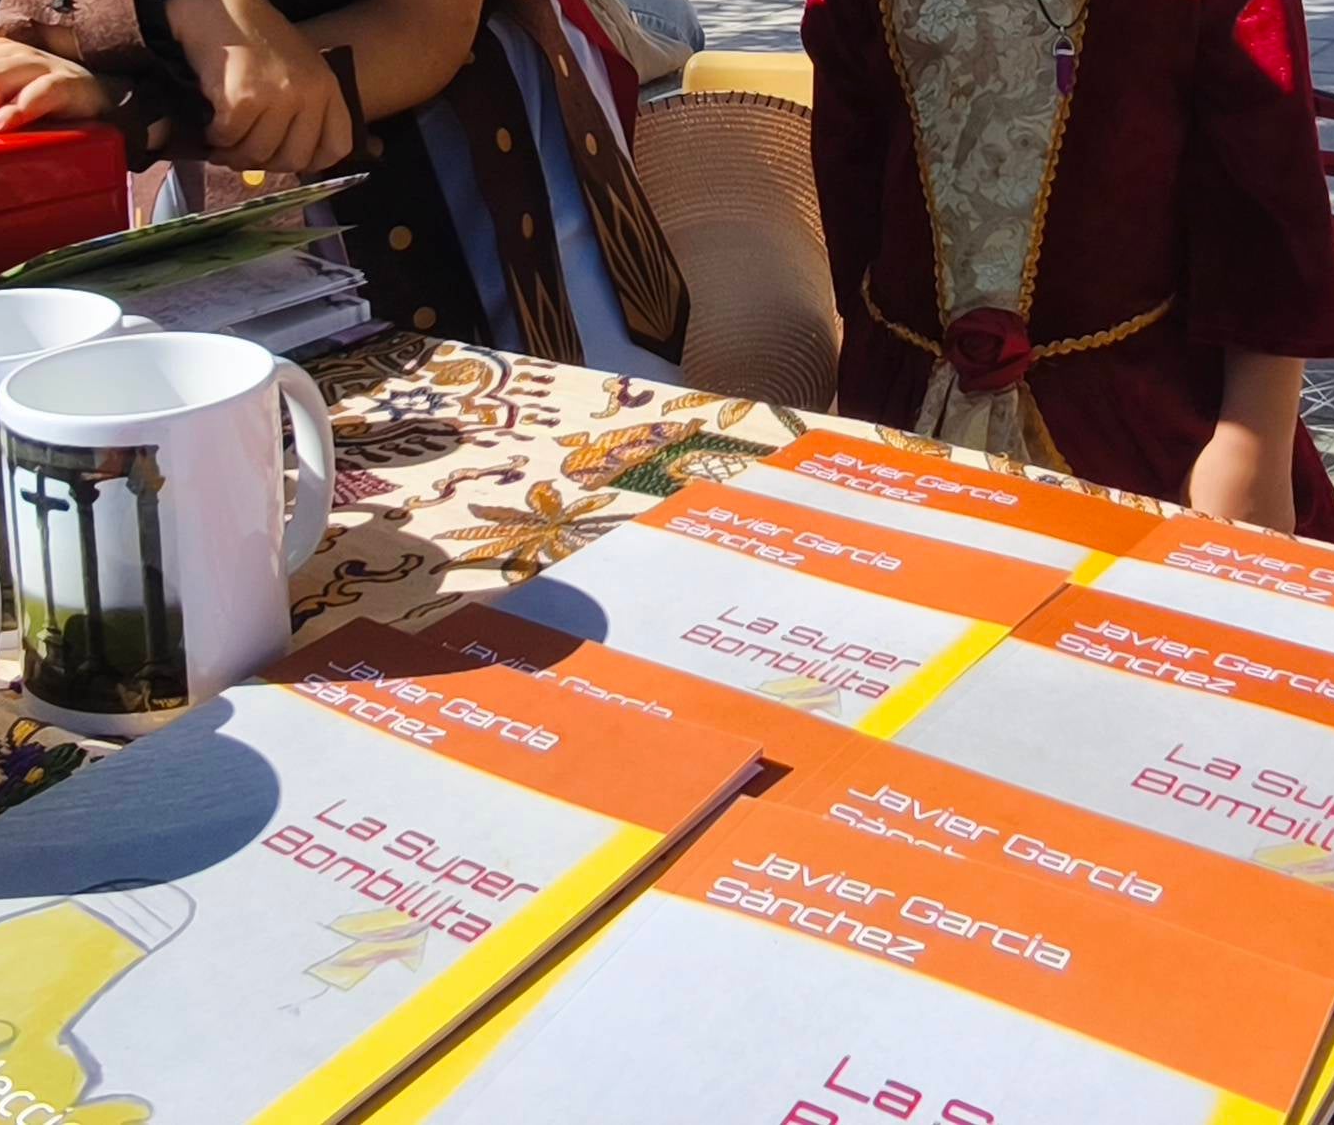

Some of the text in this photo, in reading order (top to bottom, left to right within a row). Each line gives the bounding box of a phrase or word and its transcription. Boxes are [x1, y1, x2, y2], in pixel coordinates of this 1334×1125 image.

[665, 516, 805, 566] Sánchez
[687, 506, 794, 537] Javier
[1163, 551, 1334, 602] Sánchez
[1179, 541, 1306, 573] Javier
[680, 624, 891, 700] Bombillita
[717, 605, 921, 673] La Super
[1055, 632, 1237, 694] Sánchez
[1073, 619, 1210, 660] Javier
[293, 673, 448, 745] Sánchez
[328, 660, 444, 704] Javier
[1164, 743, 1242, 781] La
[847, 784, 1000, 841] Javier
[314, 798, 540, 901] La Super
[260, 824, 492, 943] Bombillita
[731, 853, 896, 905] Javier
[705, 875, 926, 964] Sánchez
[823, 1053, 923, 1121] La
